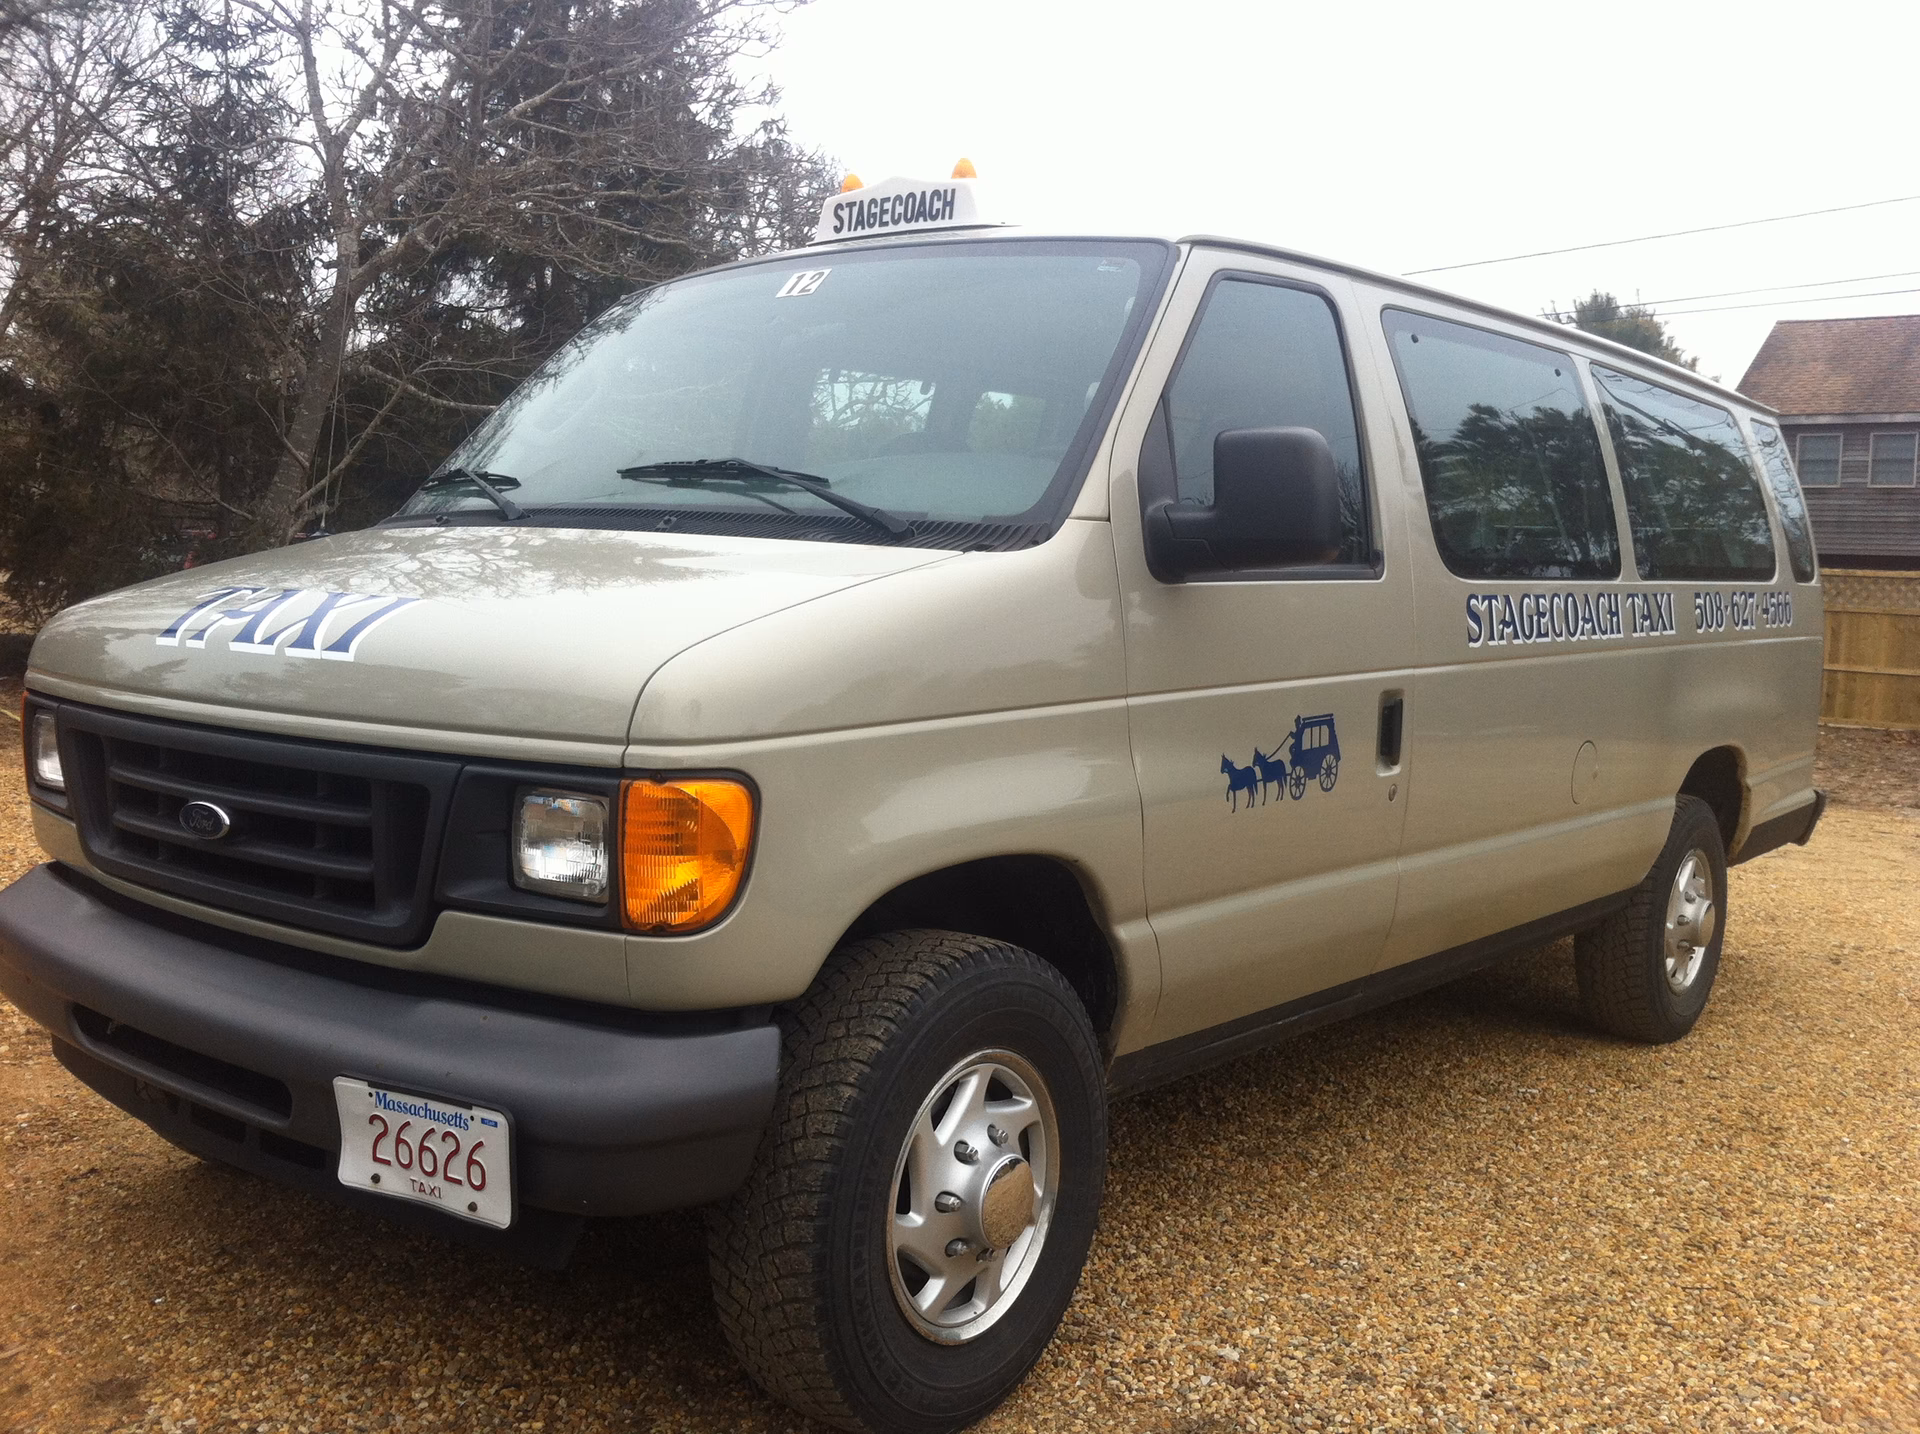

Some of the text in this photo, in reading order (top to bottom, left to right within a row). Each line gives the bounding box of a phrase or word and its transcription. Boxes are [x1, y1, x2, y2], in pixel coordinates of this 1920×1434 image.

[833, 188, 956, 234] STAGECOACH
[785, 271, 825, 295] 12
[156, 586, 424, 661] TAXI
[1466, 593, 1625, 648] STAGECOACH
[1626, 592, 1677, 637] TAXI
[374, 1091, 470, 1131] Massachusetts
[368, 1113, 487, 1192] 26626
[409, 1176, 443, 1200] TAXI
